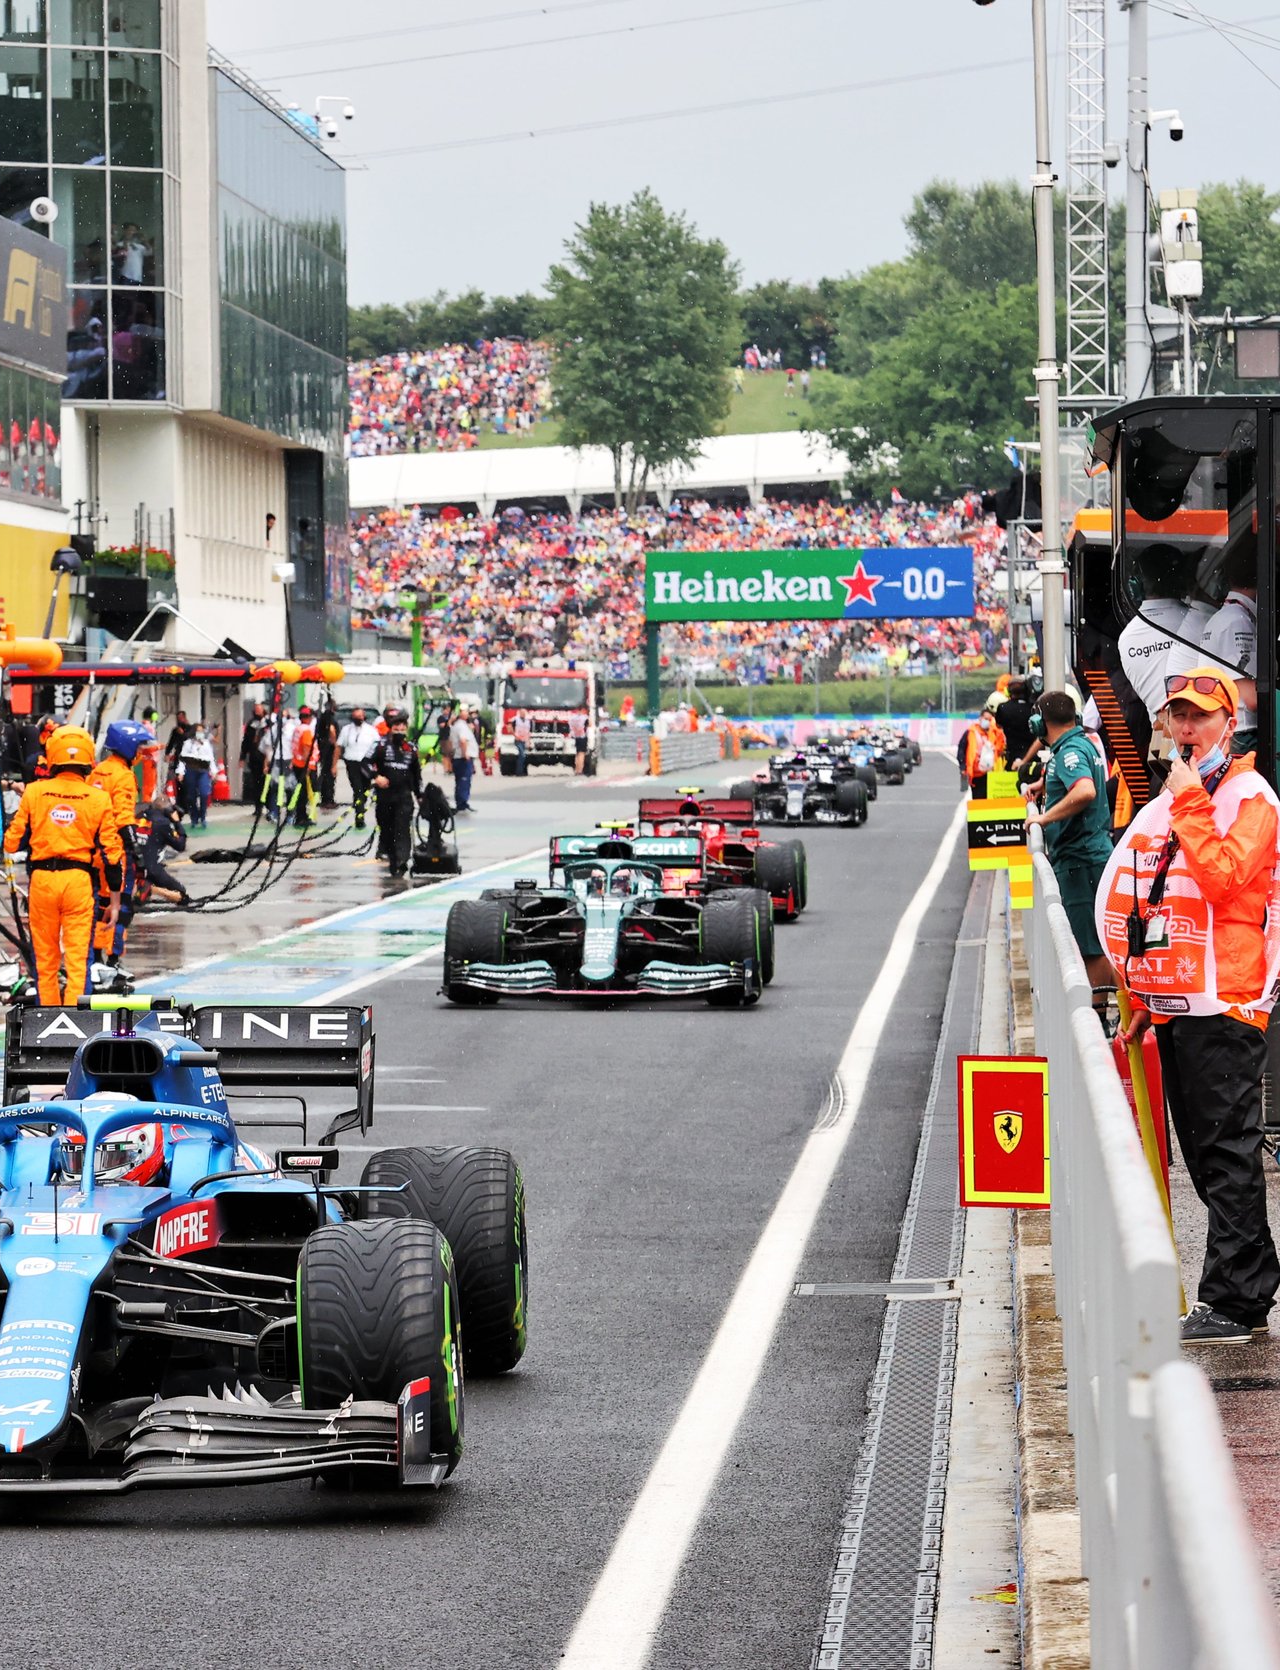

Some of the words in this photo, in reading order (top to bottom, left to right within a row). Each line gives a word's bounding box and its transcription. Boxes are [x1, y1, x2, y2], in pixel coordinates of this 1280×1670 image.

[653, 570, 834, 604] Heineken
[52, 810, 74, 820] Gulf
[62, 1144, 116, 1153] ALPNE
[296, 1157, 321, 1165] Castrol
[21, 1212, 102, 1236] 31
[160, 1209, 209, 1257] MAPFRE
[16, 1346, 71, 1358] Microsoft
